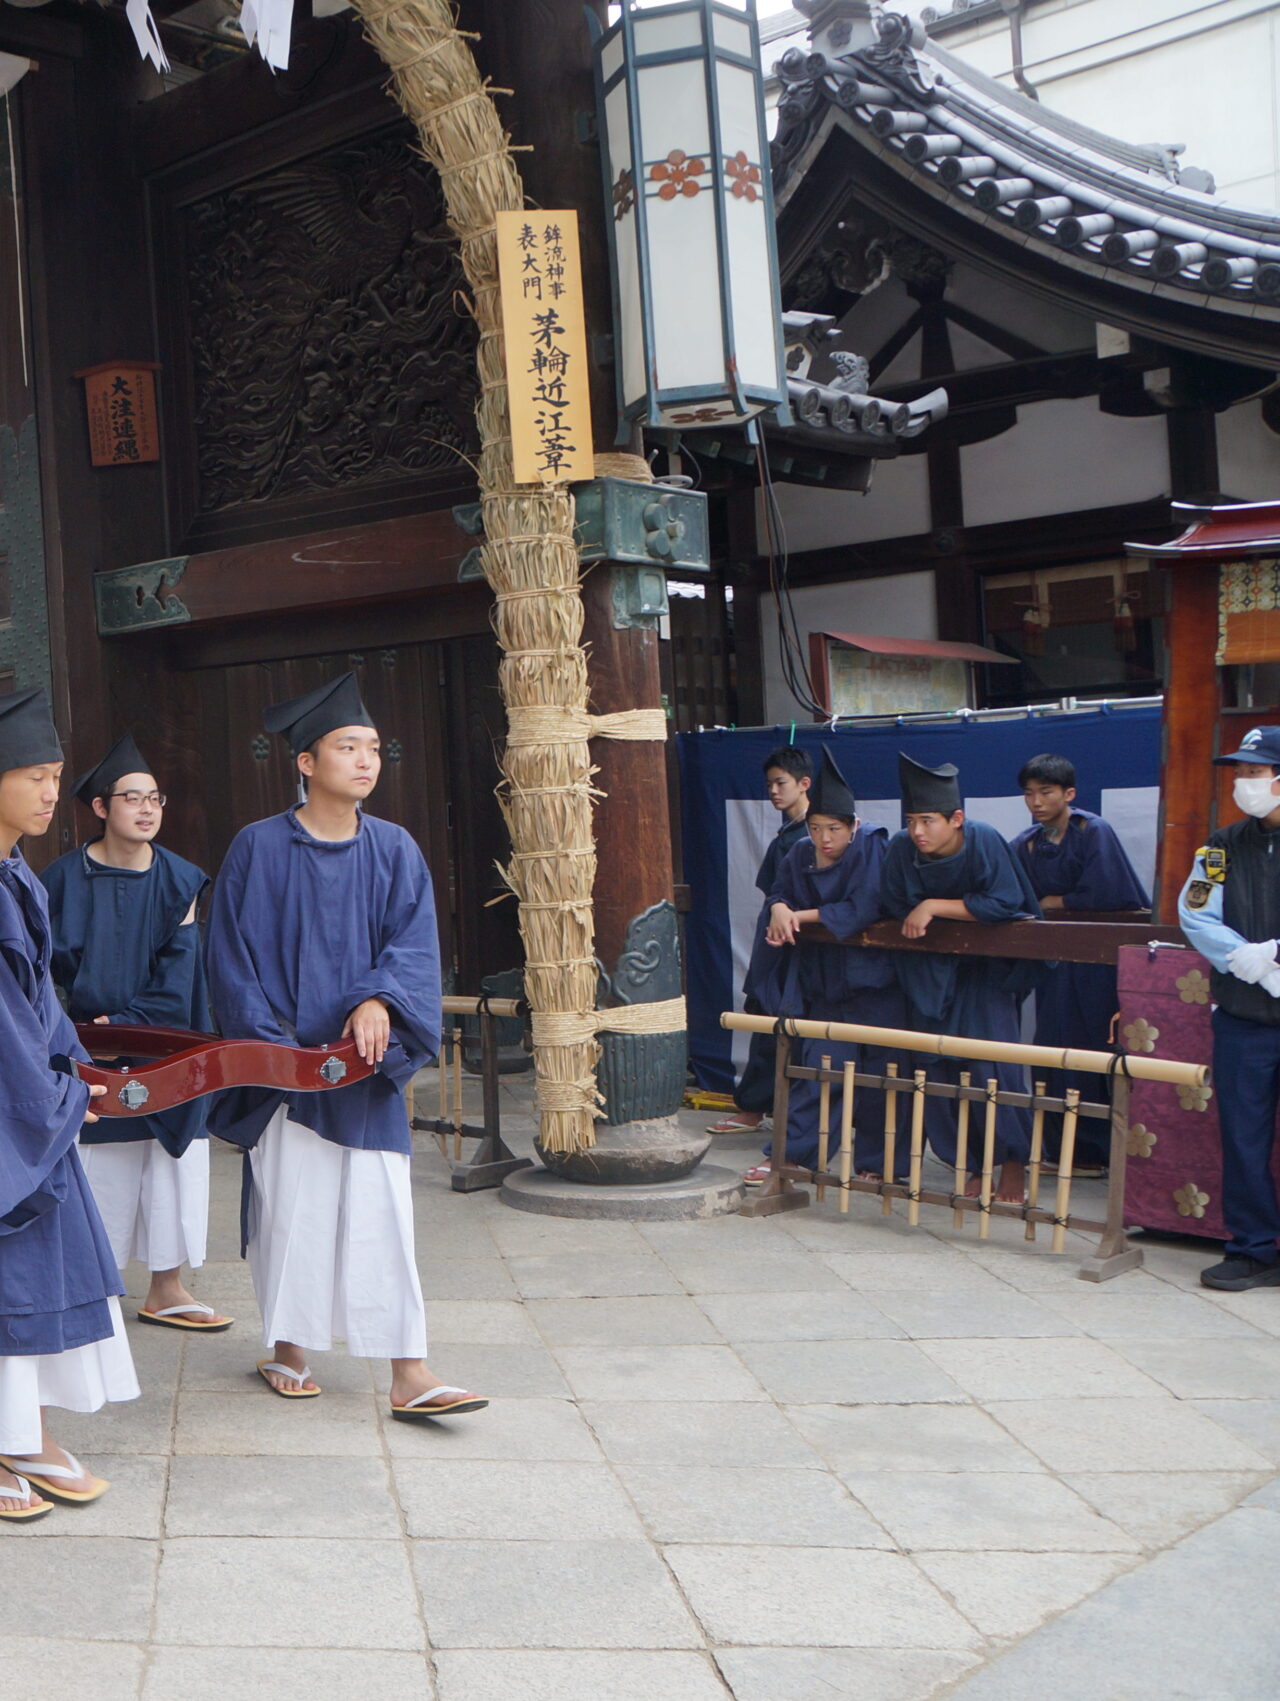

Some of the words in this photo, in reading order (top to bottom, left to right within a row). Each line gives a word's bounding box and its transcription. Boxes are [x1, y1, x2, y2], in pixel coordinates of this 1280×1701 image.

[517, 223, 542, 300] 表大門
[542, 224, 567, 300] 鉾流神事
[110, 375, 140, 462] 大注連縄
[527, 308, 577, 476] 茅輪近江葦
